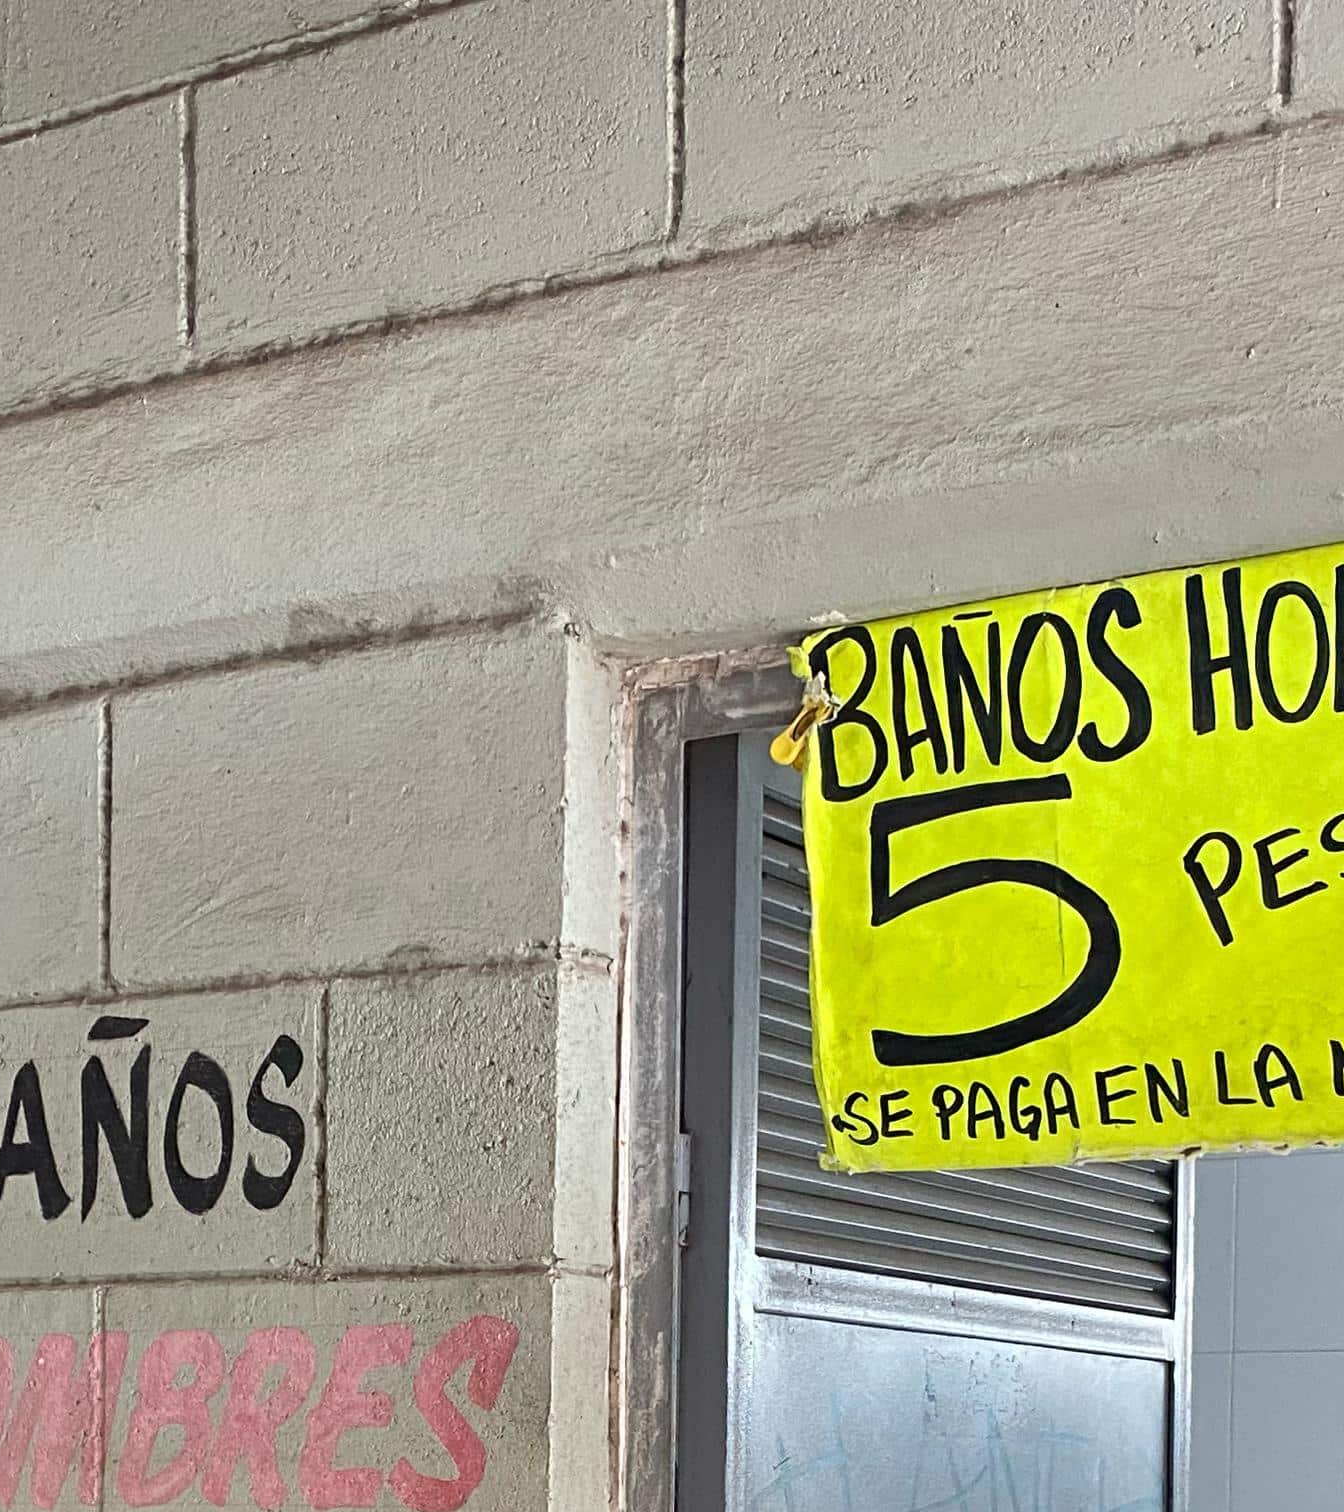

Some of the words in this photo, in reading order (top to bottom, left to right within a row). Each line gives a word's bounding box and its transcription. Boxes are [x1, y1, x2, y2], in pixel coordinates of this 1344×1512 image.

[809, 587, 1152, 802] BAÑOS
[870, 772, 1122, 1066] 5
[831, 1089, 914, 1146] SE
[931, 1072, 1080, 1141] PAGA
[1094, 1058, 1190, 1125] EN
[1214, 1043, 1305, 1108] LA
